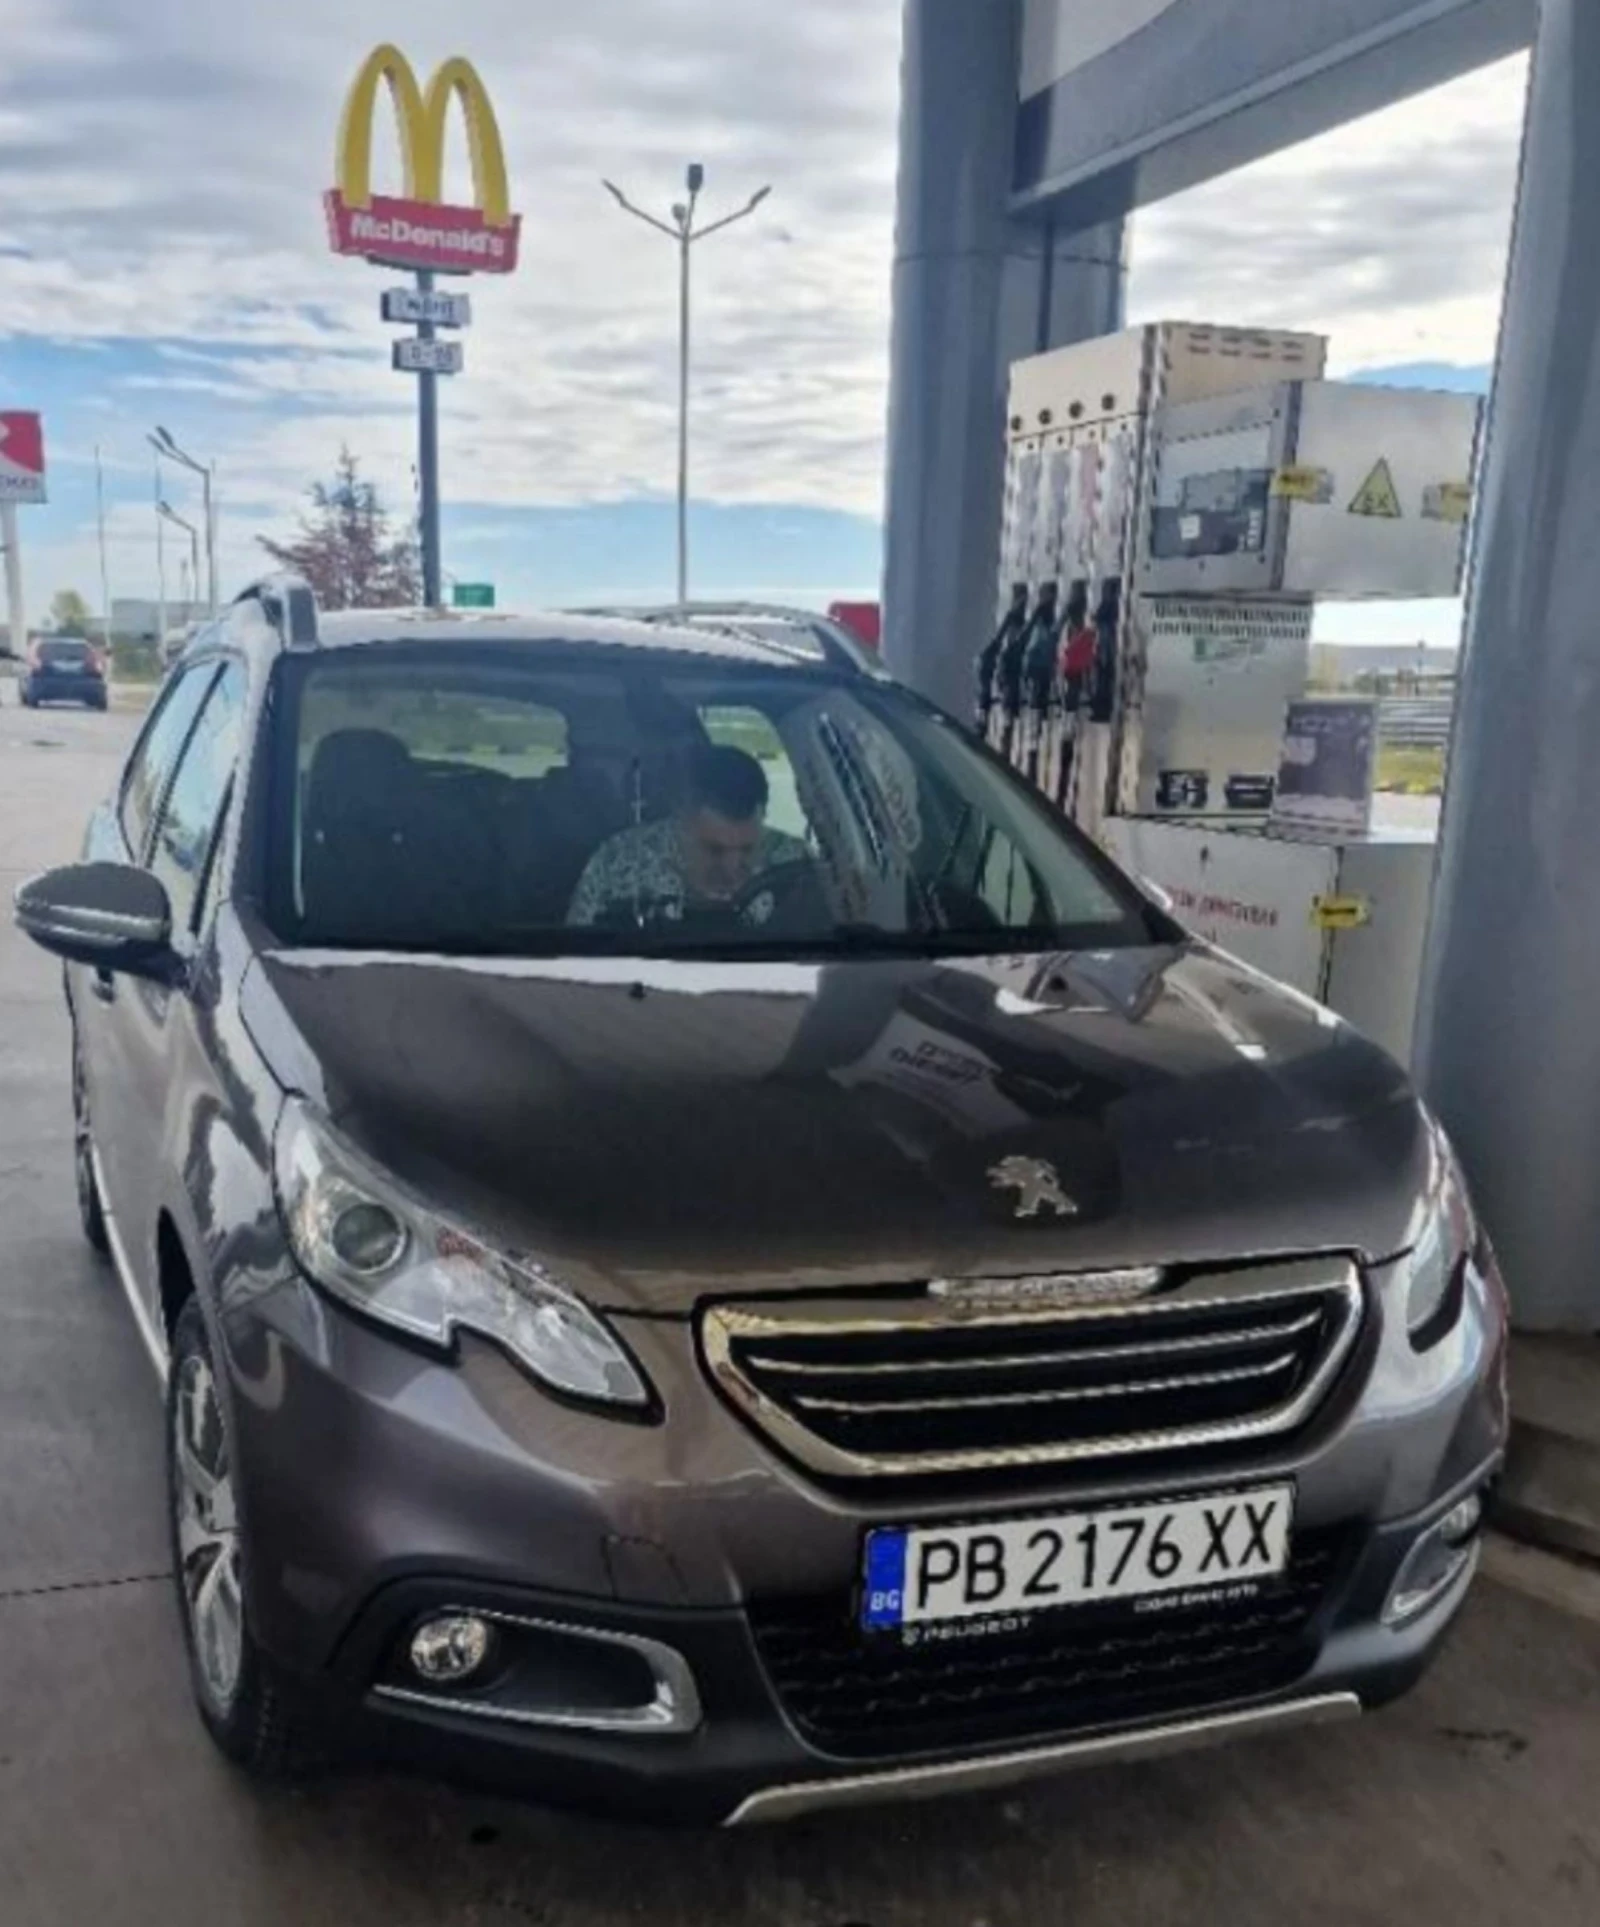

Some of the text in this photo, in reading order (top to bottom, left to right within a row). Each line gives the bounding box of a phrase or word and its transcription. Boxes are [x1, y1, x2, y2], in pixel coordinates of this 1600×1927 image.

[351, 214, 504, 257] McDonald's
[917, 1500, 1277, 1608] PB 2176 XX
[869, 1588, 900, 1612] BG
